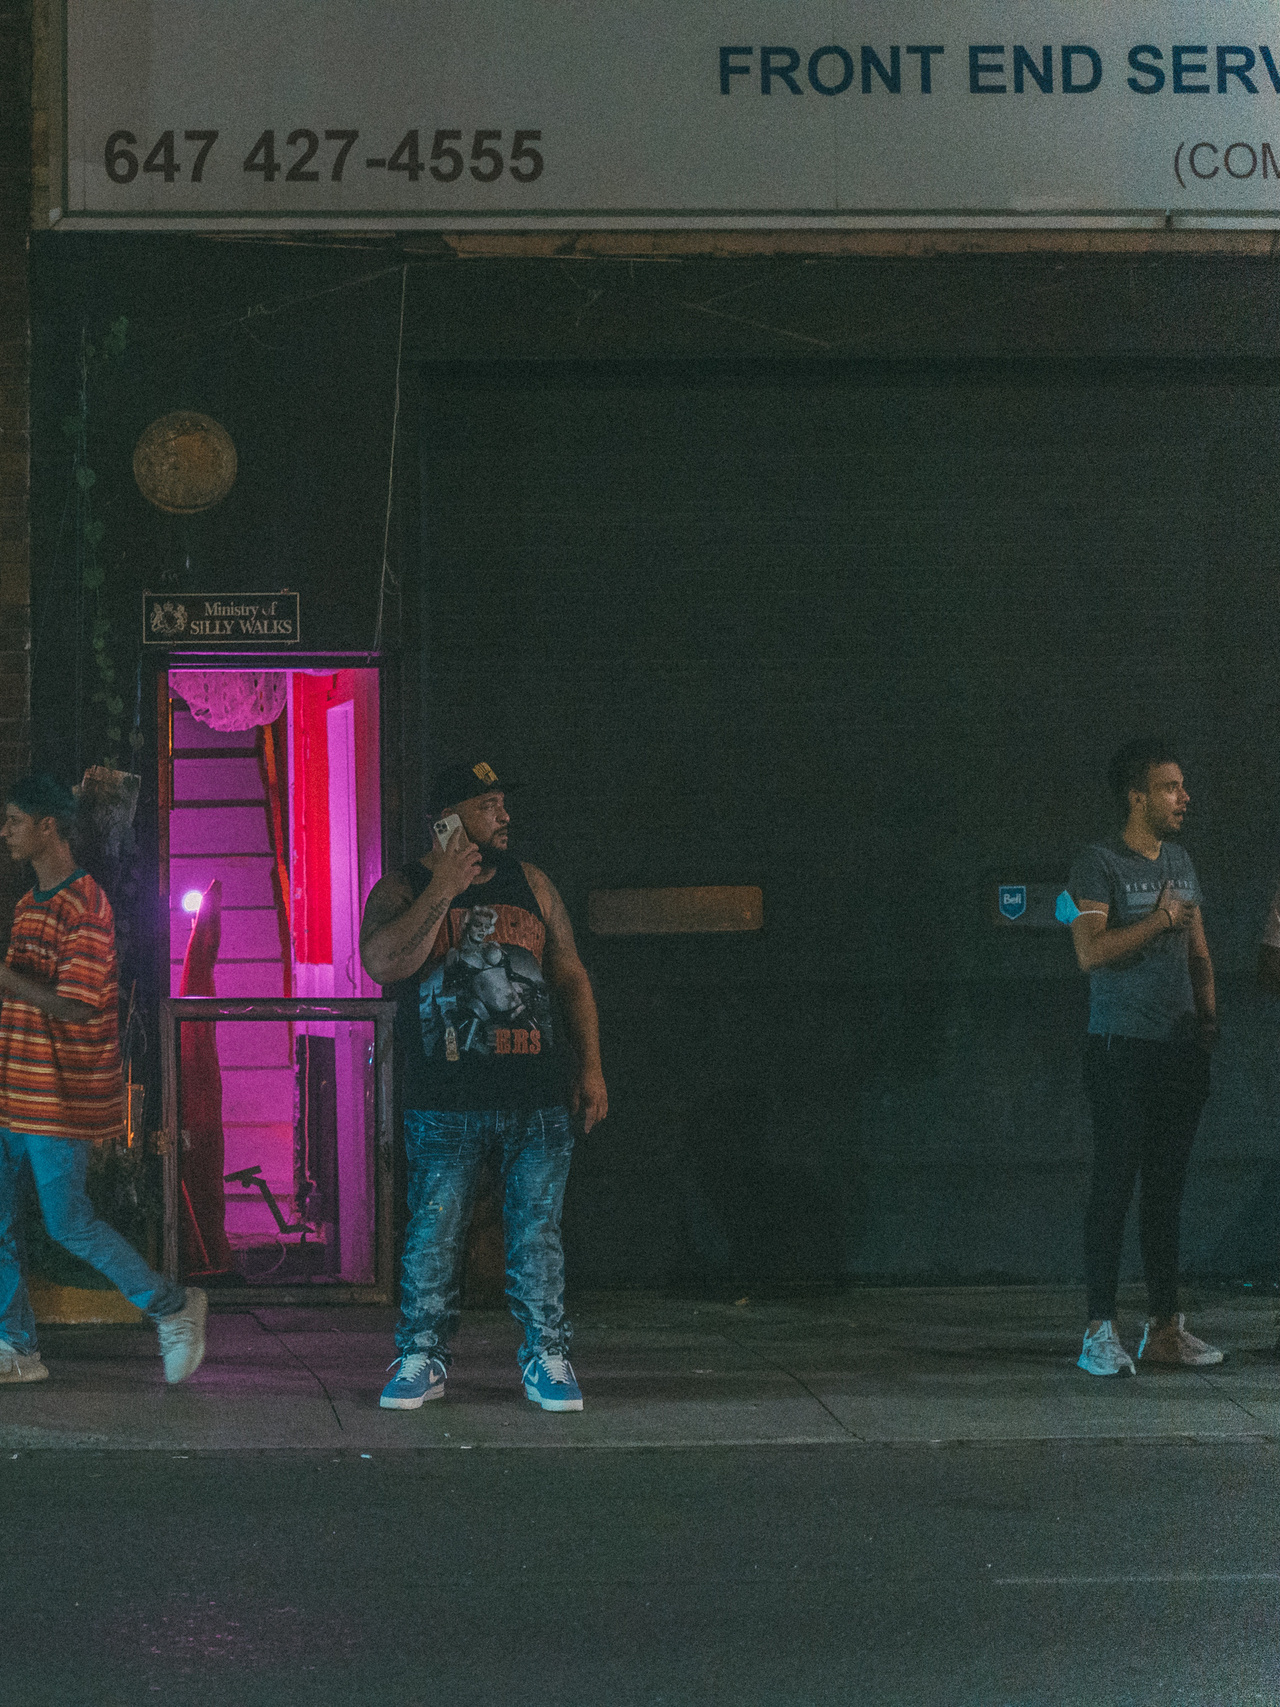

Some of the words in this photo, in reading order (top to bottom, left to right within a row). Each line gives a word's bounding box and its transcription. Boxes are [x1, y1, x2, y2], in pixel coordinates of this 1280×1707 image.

[718, 45, 944, 96] FRONT
[969, 45, 1103, 95] END
[104, 128, 218, 184] 647
[243, 128, 544, 183] 427-4555
[204, 602, 259, 620] Ministry
[261, 601, 277, 616] of
[190, 620, 234, 635] SILLY
[239, 619, 293, 635] WALKS
[1003, 893, 1022, 905] Bell
